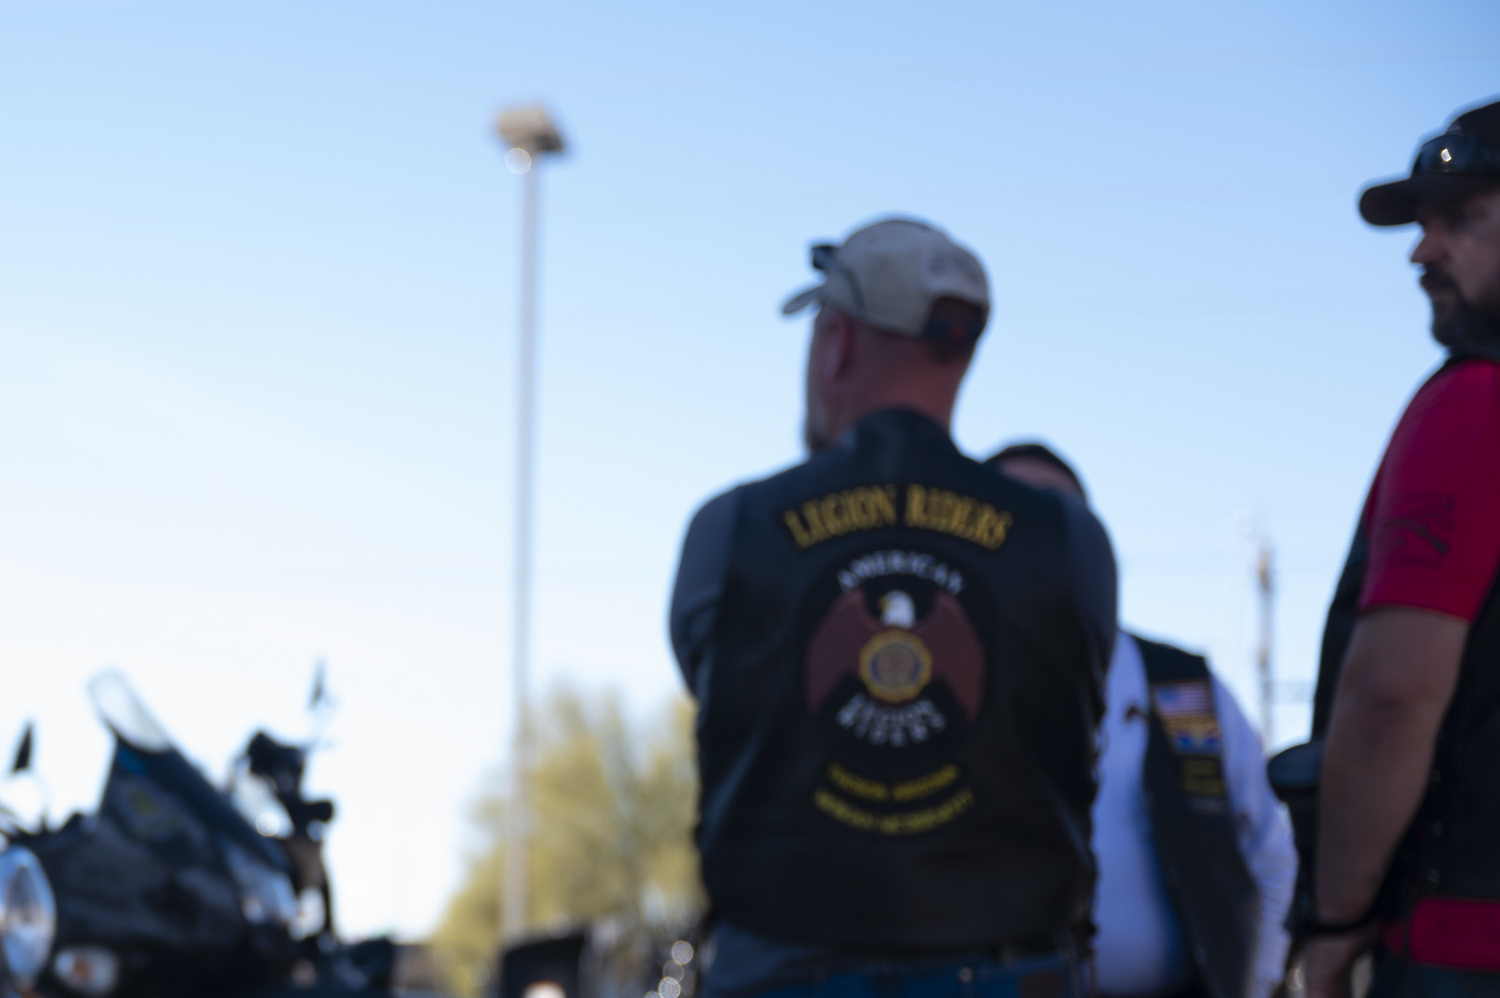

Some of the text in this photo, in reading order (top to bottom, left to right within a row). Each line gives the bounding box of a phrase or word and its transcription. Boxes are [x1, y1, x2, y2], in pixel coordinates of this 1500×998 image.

[783, 484, 1013, 550] LEGION RIDERS
[838, 550, 964, 595] AMERICAN
